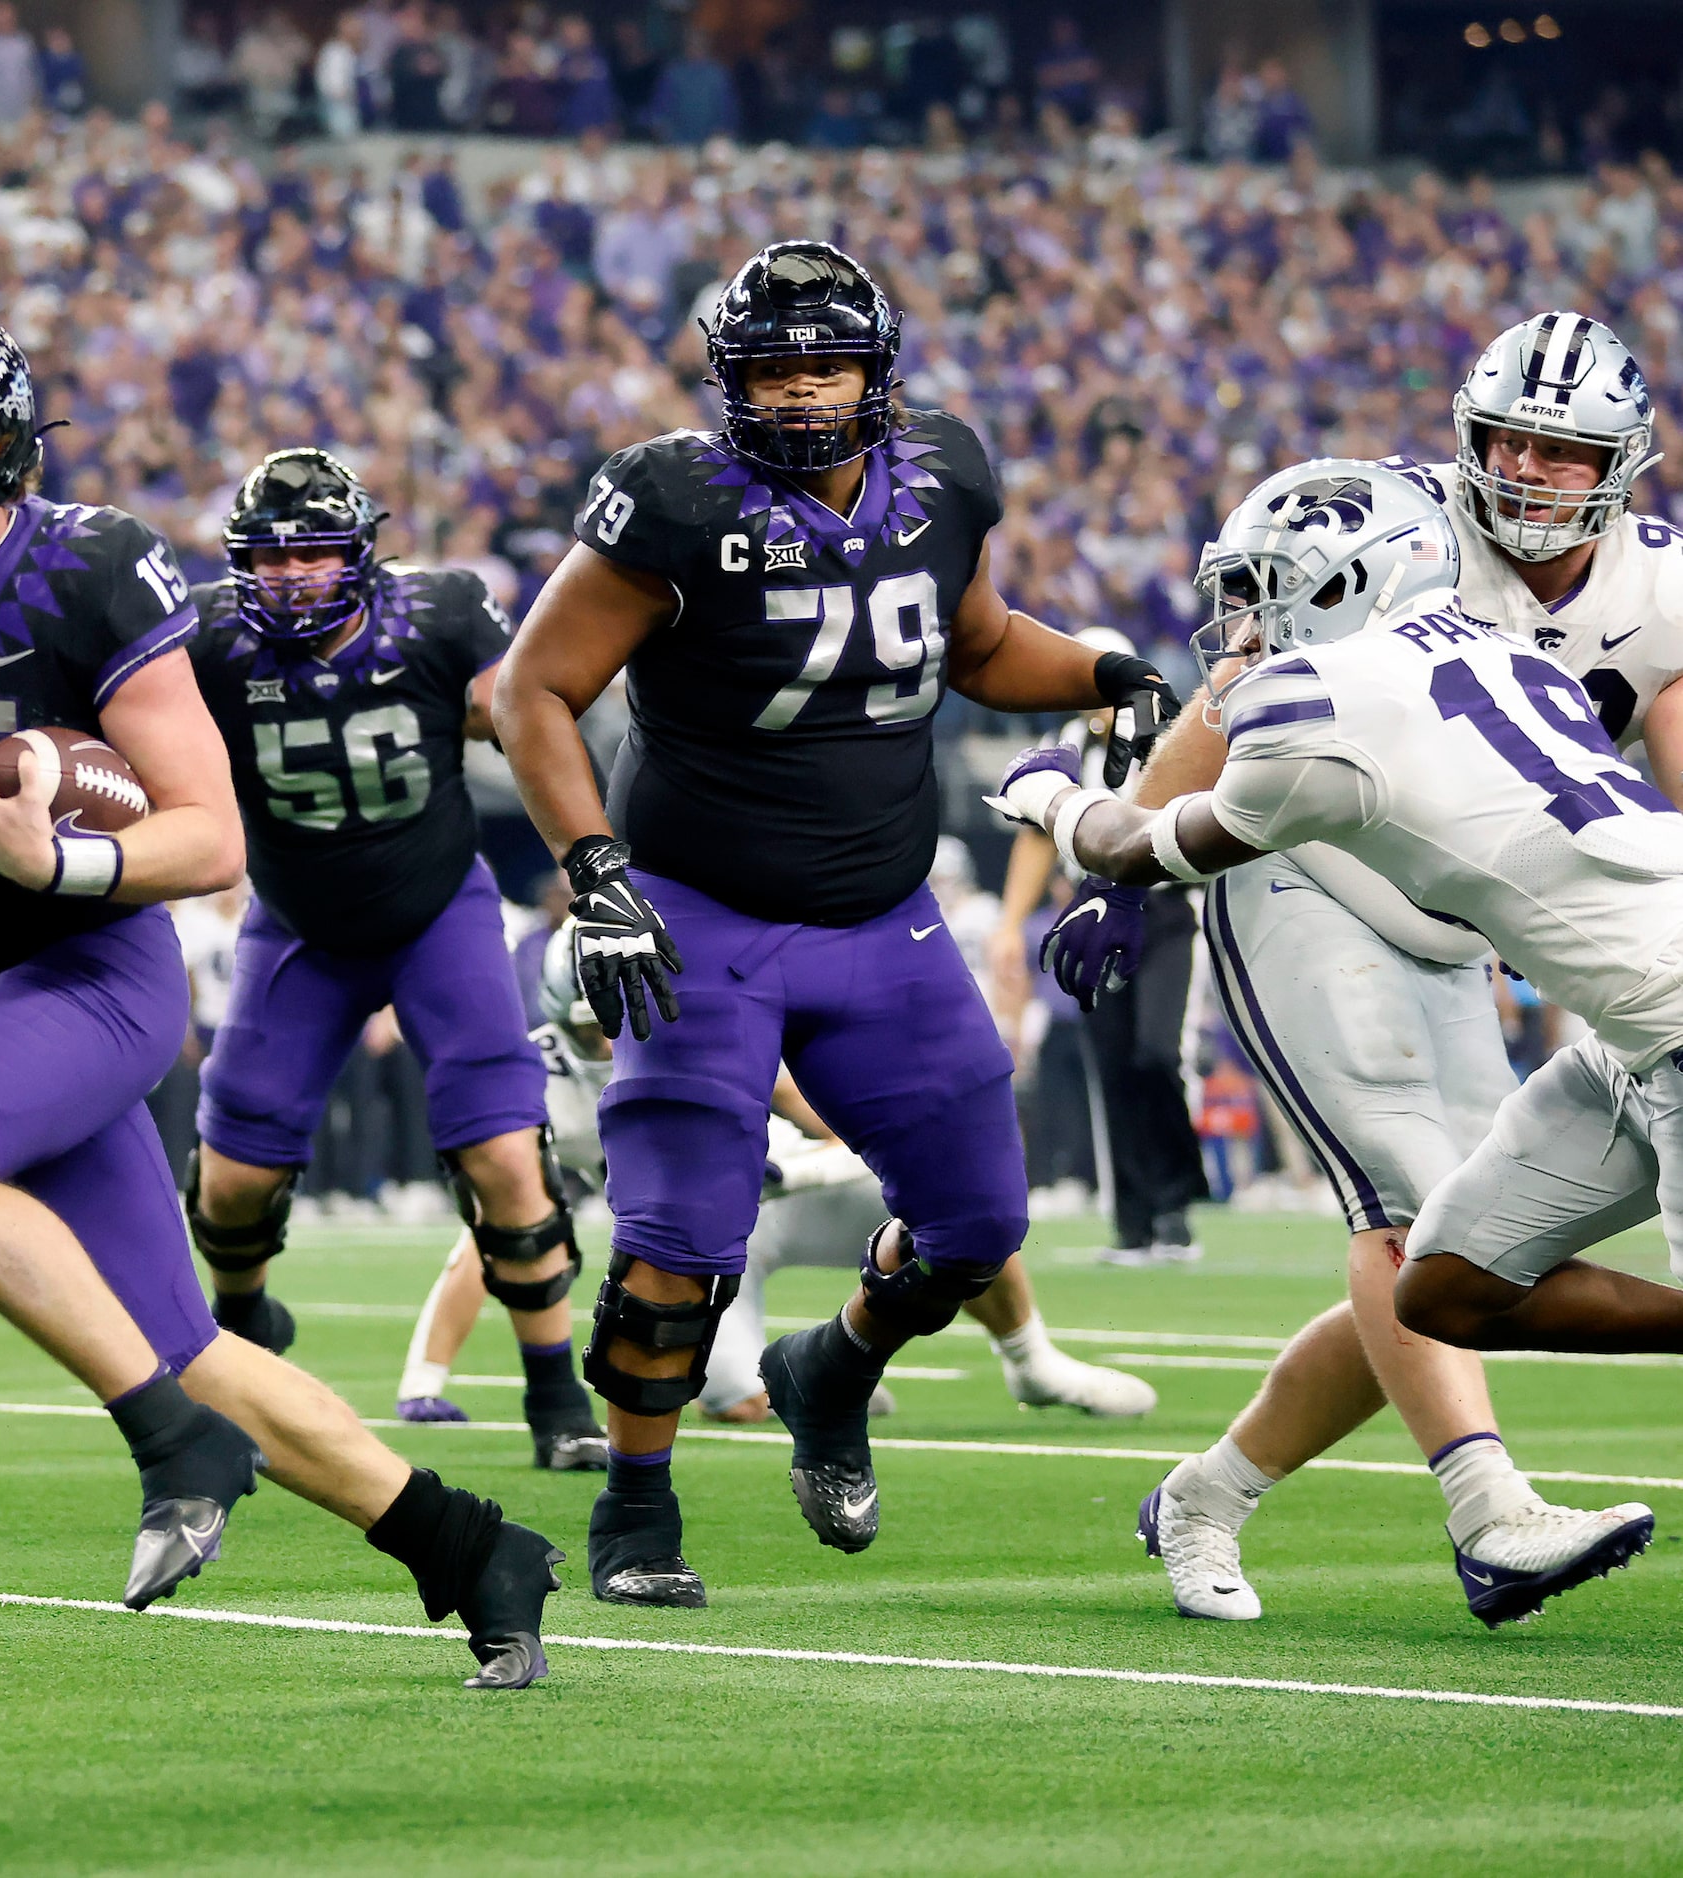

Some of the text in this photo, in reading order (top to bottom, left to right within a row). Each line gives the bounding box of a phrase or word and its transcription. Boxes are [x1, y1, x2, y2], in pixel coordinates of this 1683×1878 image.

[786, 327, 817, 342] TCU
[1520, 403, 1567, 419] K-STATE
[583, 475, 635, 546] 79
[843, 537, 865, 554] TCU
[135, 541, 189, 615] 15
[721, 534, 750, 572] C
[752, 571, 946, 731] 79
[252, 703, 431, 832] 56
[1429, 652, 1683, 836] 19
